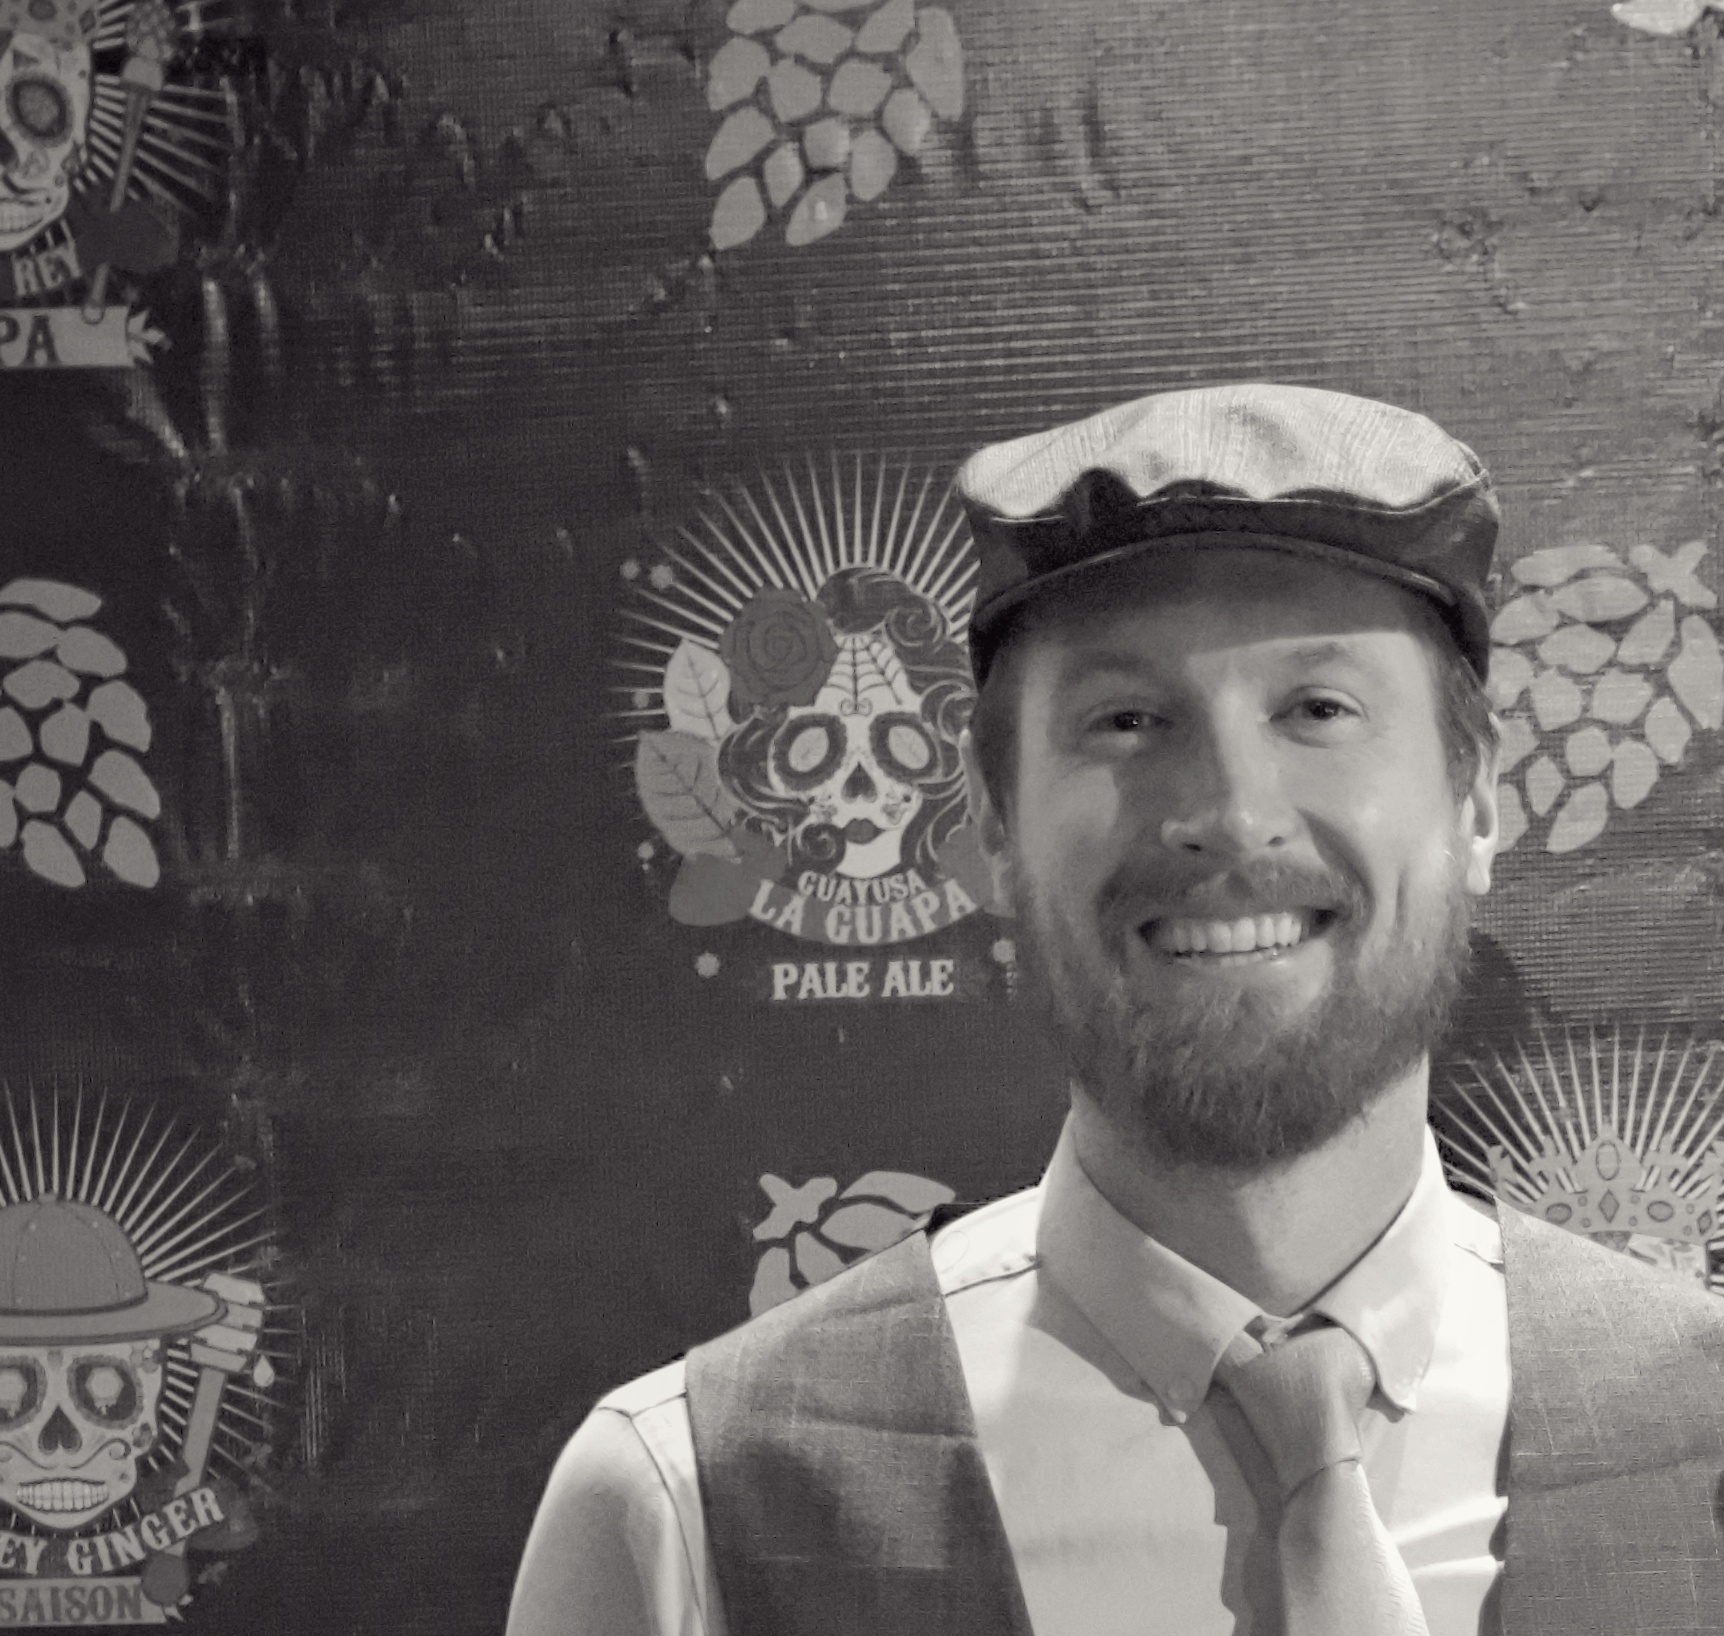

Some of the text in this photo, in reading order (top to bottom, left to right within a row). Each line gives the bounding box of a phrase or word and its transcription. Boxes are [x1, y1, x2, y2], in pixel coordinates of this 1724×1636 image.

[749, 877, 978, 944] LA GUAPA
[771, 958, 955, 1001] PALE ALE
[66, 1486, 225, 1577] GINGER
[0, 1585, 144, 1623] SAISON
